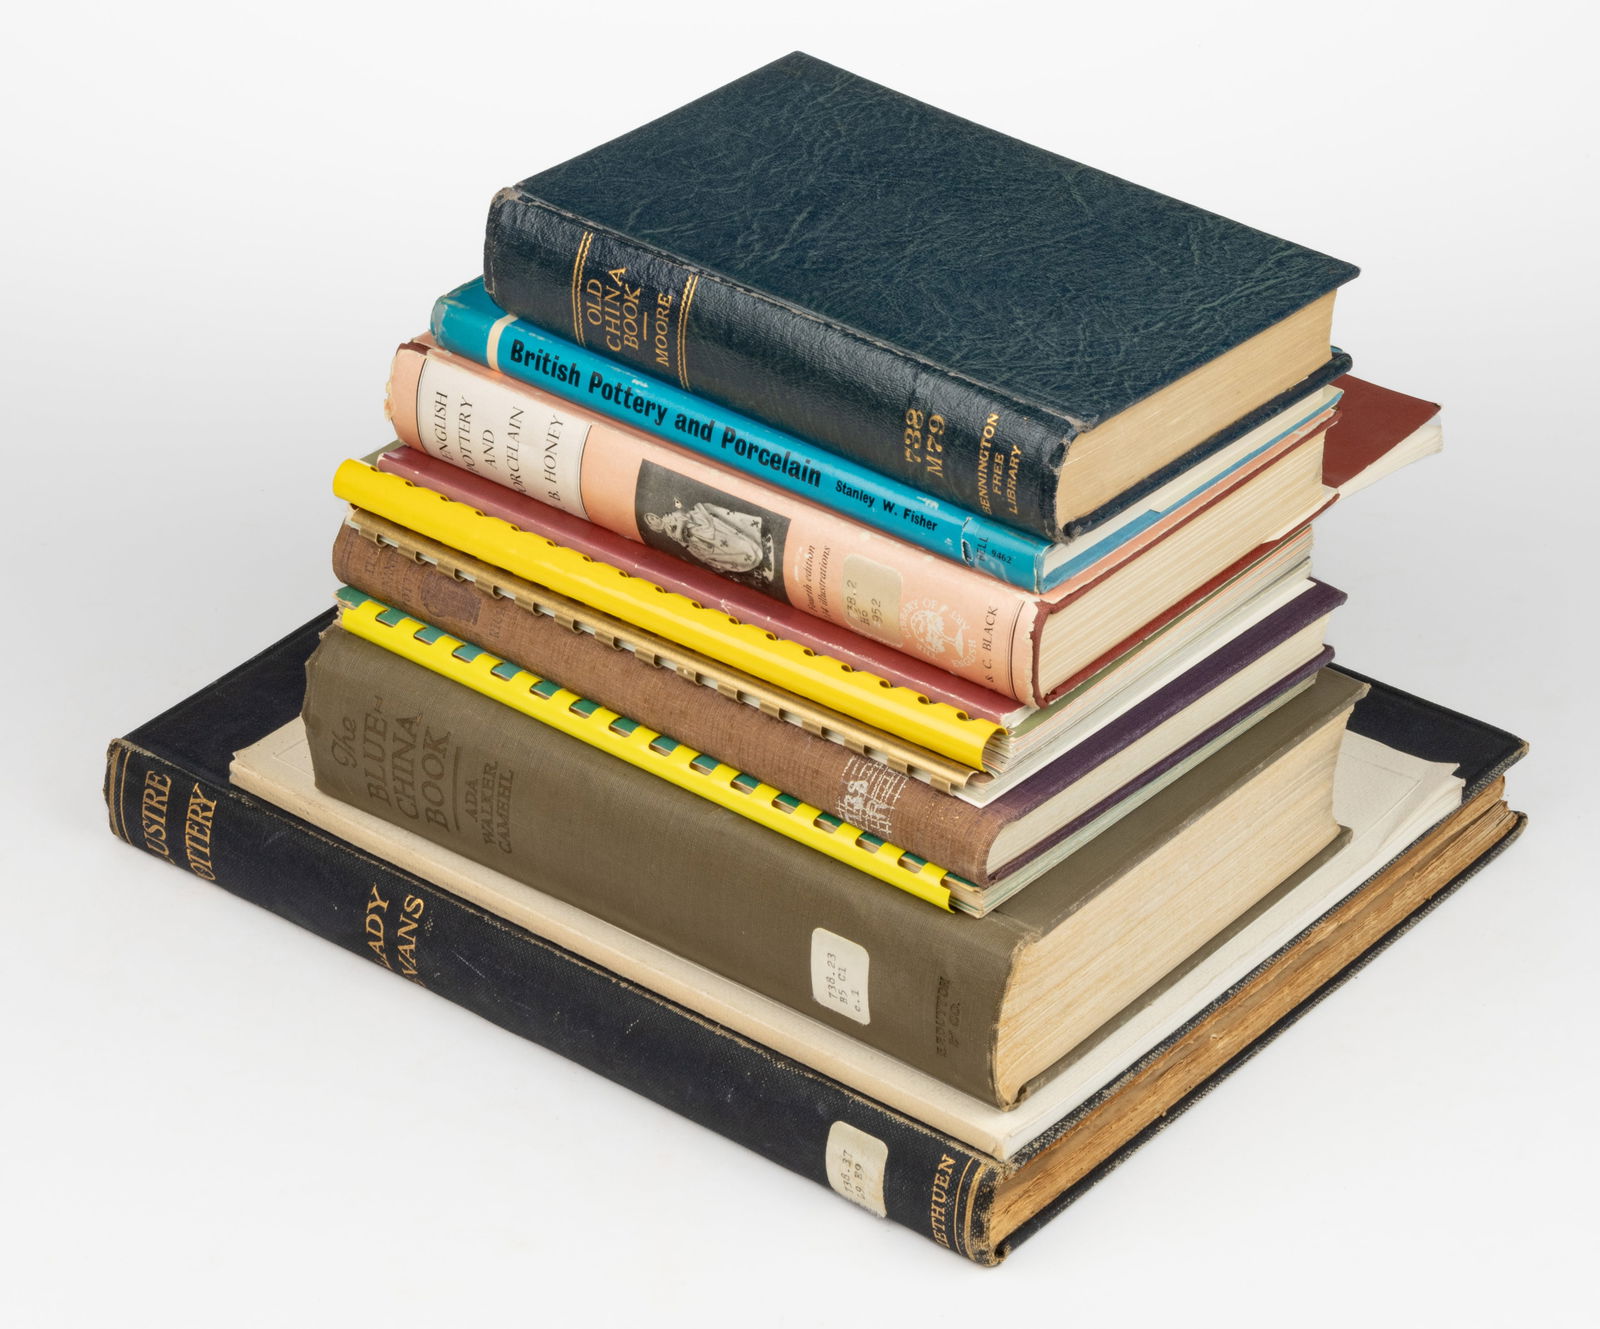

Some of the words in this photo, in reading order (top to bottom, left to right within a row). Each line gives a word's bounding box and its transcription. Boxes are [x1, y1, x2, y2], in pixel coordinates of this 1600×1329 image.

[586, 278, 603, 326] OLD
[605, 266, 628, 352] CHINA
[623, 284, 641, 350] BOOK
[655, 292, 673, 368] MOORE
[434, 391, 454, 462] ENGLISH
[482, 429, 497, 470] AND
[506, 405, 527, 493] ORCELAIN
[509, 338, 581, 387] British
[588, 370, 669, 426] Pottery
[674, 411, 715, 443] and
[721, 426, 822, 489] Porcelain
[835, 479, 875, 508] Stanley
[883, 498, 898, 516] W.
[903, 508, 939, 531] Fisher
[543, 414, 564, 484] HONEY
[904, 407, 925, 464] 738
[925, 413, 946, 479] M79
[977, 411, 1000, 515] BENNINGTON
[992, 452, 1005, 496] FREE
[1007, 444, 1022, 514] LIBRARY
[803, 544, 816, 582] edition
[817, 544, 831, 607] illustrations
[982, 606, 999, 651] BLACK
[331, 715, 357, 769] The
[391, 714, 422, 820] CHINA
[421, 725, 452, 832] BOOK
[465, 778, 480, 823] ADA
[480, 761, 498, 846] WALKER
[142, 770, 174, 864] USTRE
[185, 782, 218, 881] OTTERY
[397, 894, 425, 982] VANS
[825, 952, 838, 1000] 738.23
